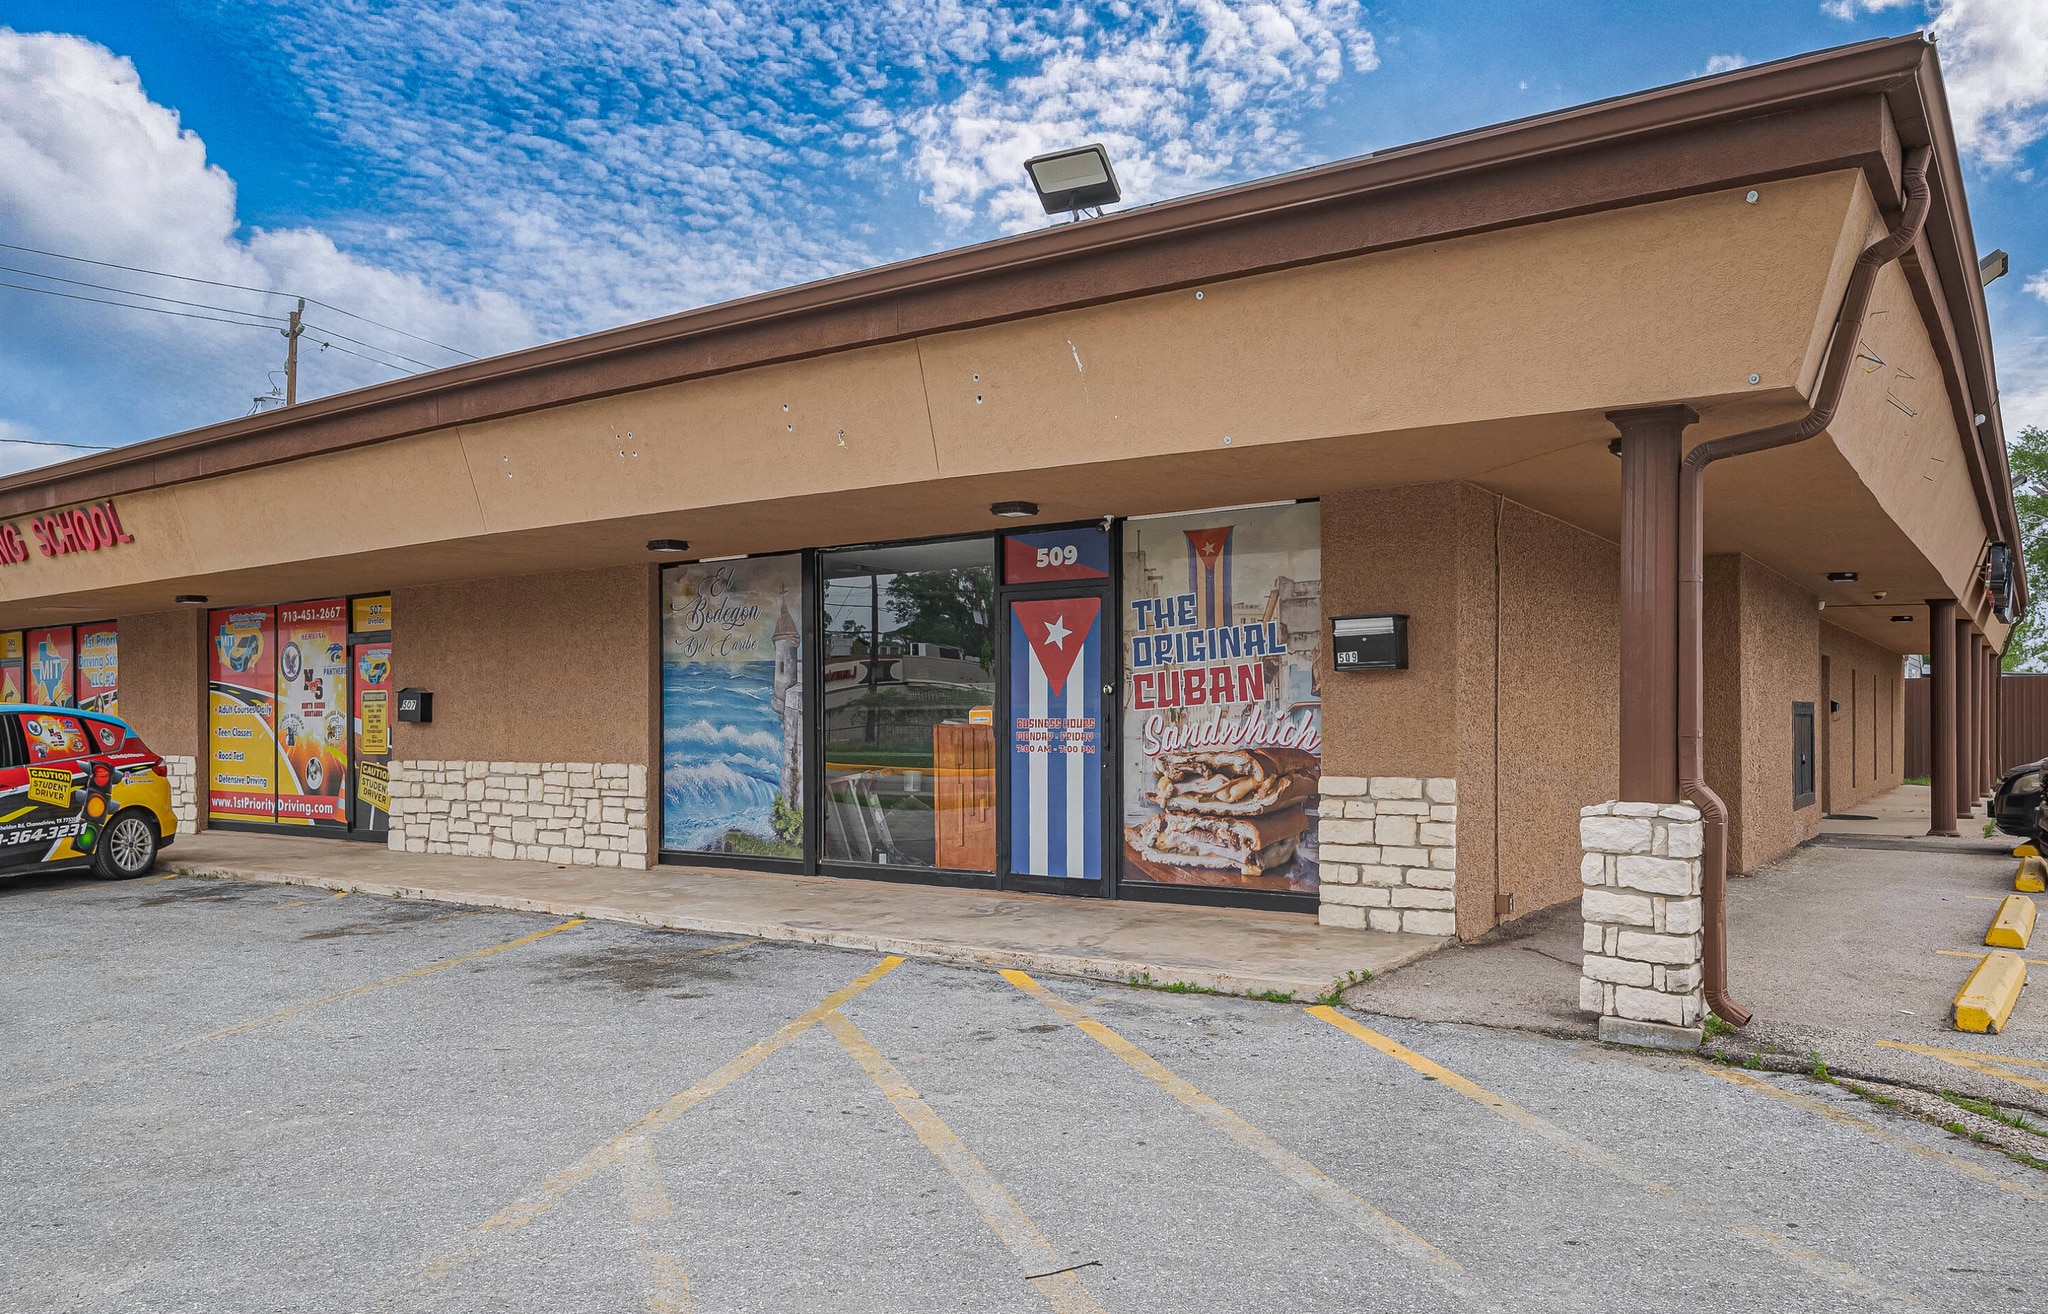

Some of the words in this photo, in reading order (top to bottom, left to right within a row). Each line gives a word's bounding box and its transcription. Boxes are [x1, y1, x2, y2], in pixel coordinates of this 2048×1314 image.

[31, 500, 134, 558] SCHOOL
[1036, 545, 1078, 567] 509
[698, 566, 735, 597] El
[282, 606, 341, 623] 713-451-2667
[370, 604, 382, 615] 507
[670, 595, 761, 632] Bodegon
[1131, 592, 1197, 631] THE
[85, 634, 94, 648] 1st
[220, 635, 234, 647] MIT
[301, 632, 326, 640] SERVING
[675, 634, 709, 658] Del
[711, 633, 758, 657] Caribe
[1132, 621, 1287, 668] ORIGINAL
[78, 653, 103, 670] Driving
[1338, 652, 1358, 663] 509
[39, 659, 60, 680] MIT
[91, 672, 103, 687] LLC
[104, 671, 116, 686] #2
[1132, 662, 1264, 711] CUBAN
[218, 704, 233, 714] Adult
[234, 704, 256, 714] Courses
[257, 703, 272, 716] Daily
[402, 700, 416, 710] 507
[1017, 718, 1061, 729] BUSINESS
[1063, 718, 1095, 729] HOURS
[218, 727, 231, 737] Teen
[232, 727, 252, 737] Classes
[1016, 731, 1053, 741] MONDAY
[1061, 731, 1094, 741] FRIDAY
[1143, 706, 1321, 757] Sandwhich
[218, 750, 232, 760] Road
[233, 751, 244, 760] Test
[1016, 744, 1035, 753] 7:00
[1037, 744, 1052, 753] AM
[1059, 744, 1078, 753] 7:00
[1080, 745, 1095, 754] PM
[31, 770, 70, 781] CAUTION
[218, 774, 245, 785] Defensive
[246, 775, 267, 787] Driving
[33, 780, 68, 793] STUDENT
[35, 788, 64, 800] DRIVER
[364, 787, 387, 804] DRIVER
